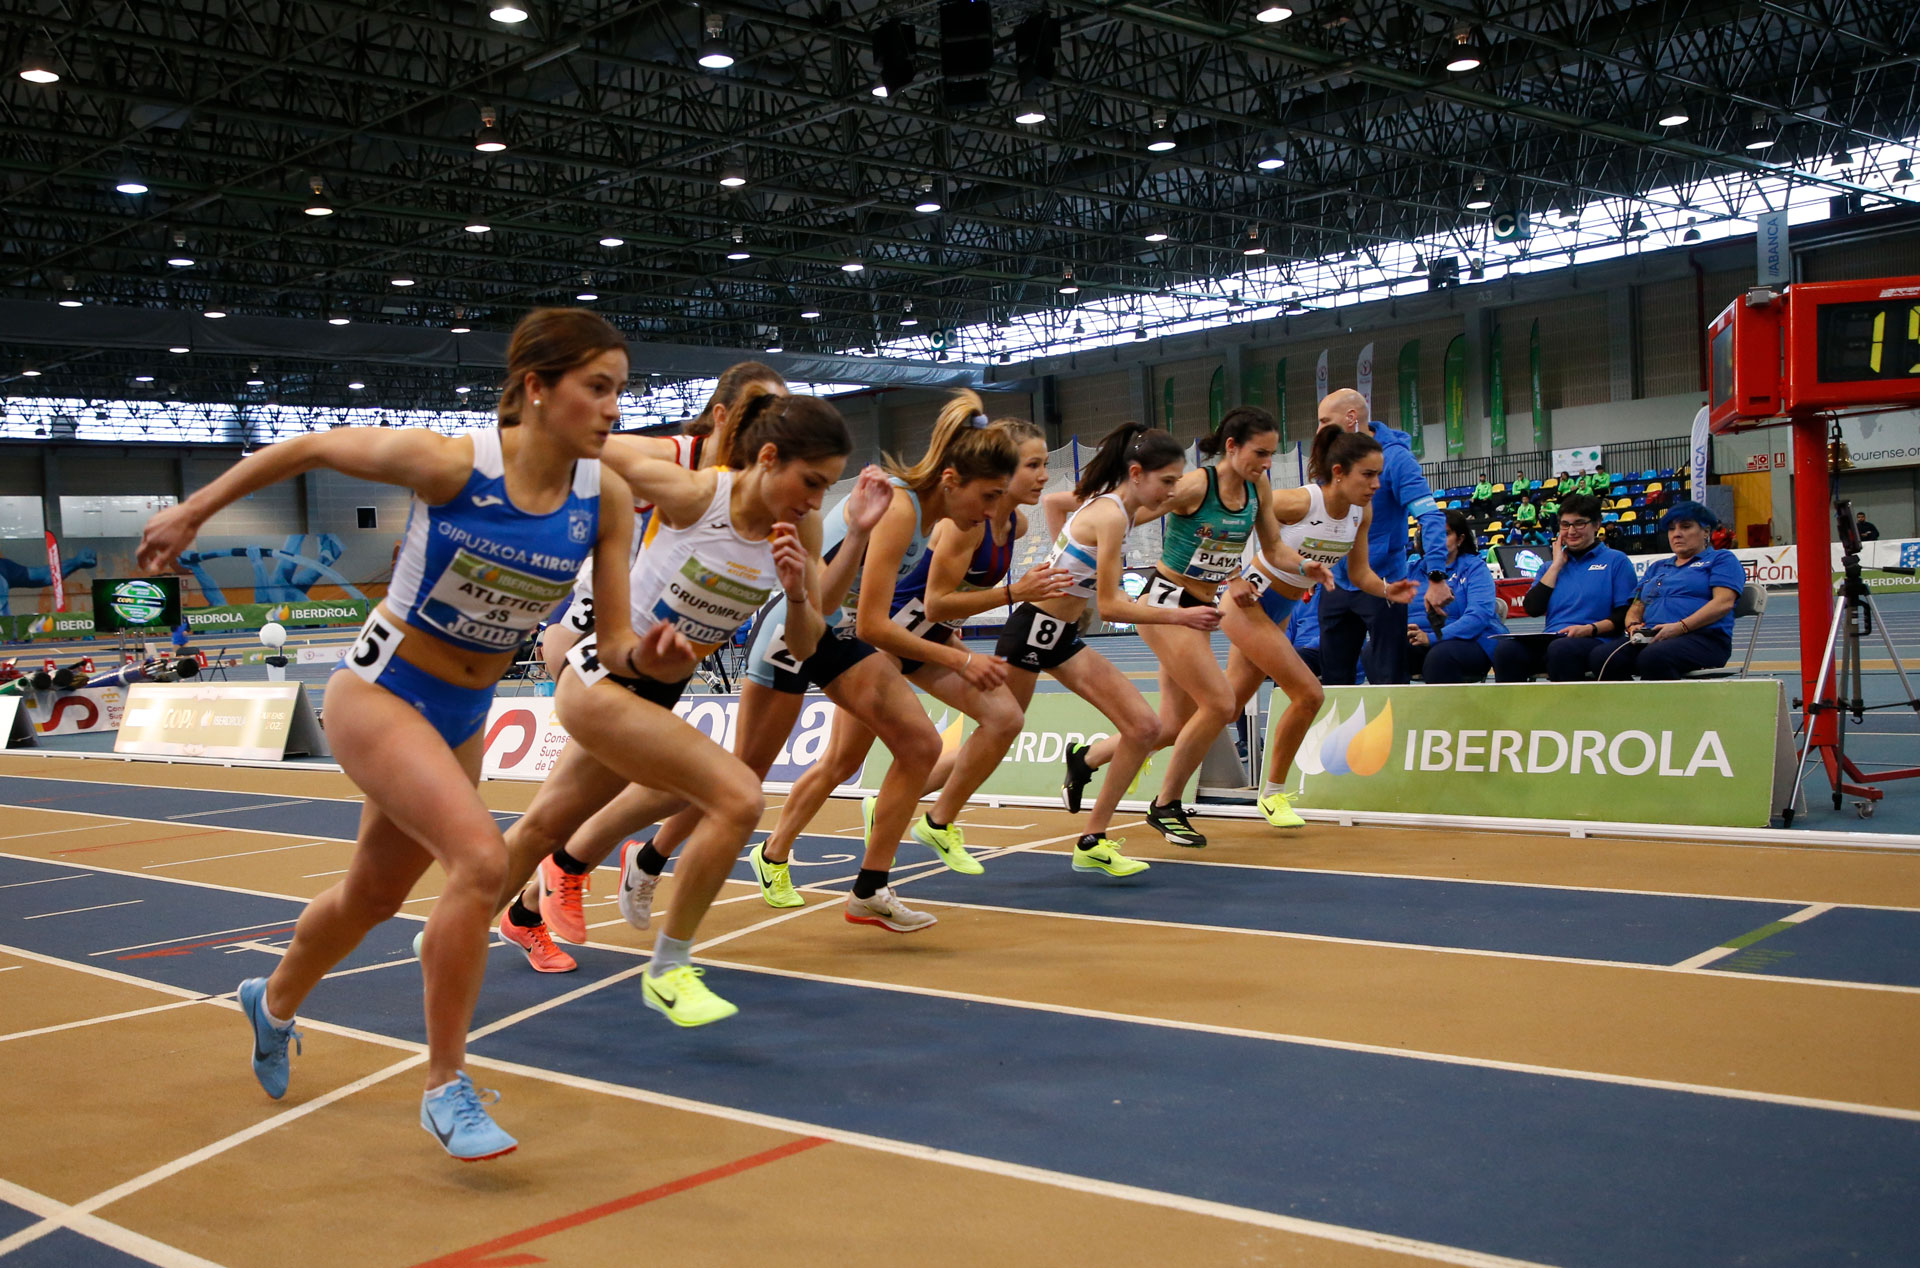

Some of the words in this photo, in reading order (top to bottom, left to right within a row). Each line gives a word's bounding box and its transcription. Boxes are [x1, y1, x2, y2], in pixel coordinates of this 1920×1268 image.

[1695, 445, 1705, 502] BANCA
[437, 521, 526, 564] GIPUZKOA
[1156, 583, 1176, 604] 7
[291, 608, 358, 619] IBERDROLA
[572, 598, 594, 632] 3
[353, 620, 390, 667] 5
[1036, 619, 1057, 645] 8
[535, 760, 546, 771] de
[1404, 729, 1734, 778] IBERDROLA
